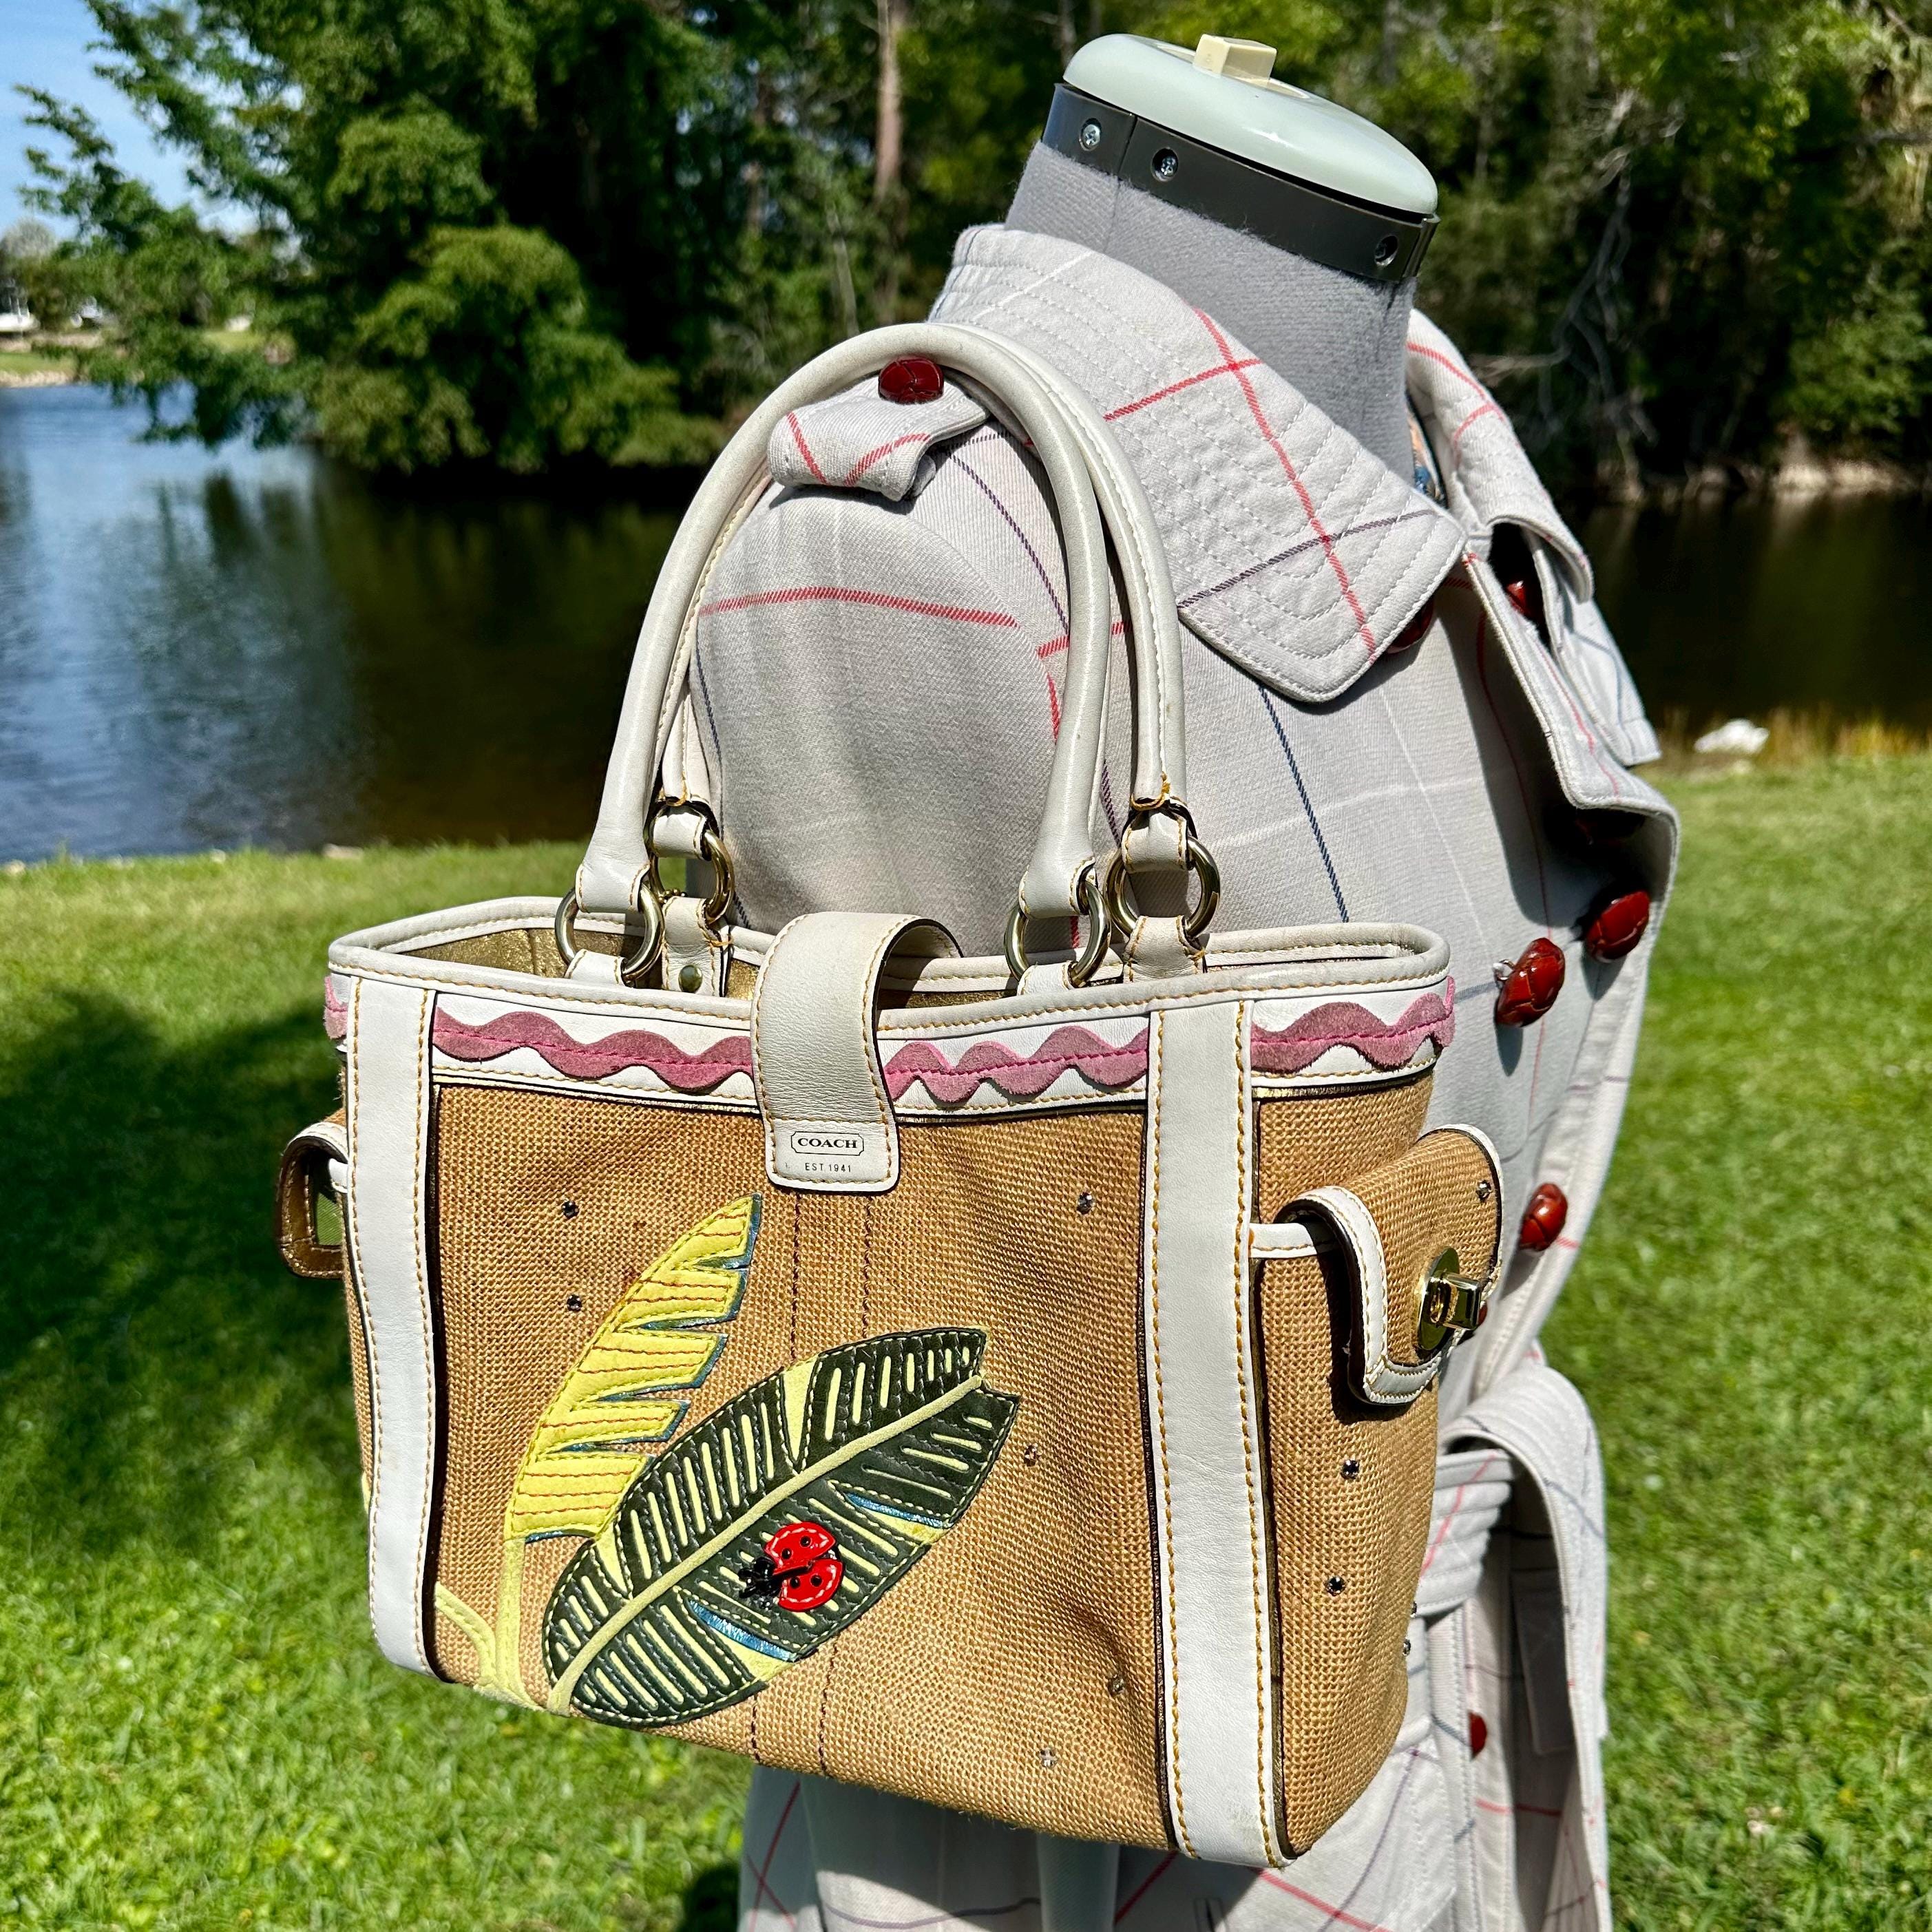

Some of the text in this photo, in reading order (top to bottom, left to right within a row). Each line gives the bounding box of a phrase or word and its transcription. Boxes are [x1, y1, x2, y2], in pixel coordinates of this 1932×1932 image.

[797, 1137, 857, 1148] COACH
[805, 1162, 851, 1173] EST 1941
